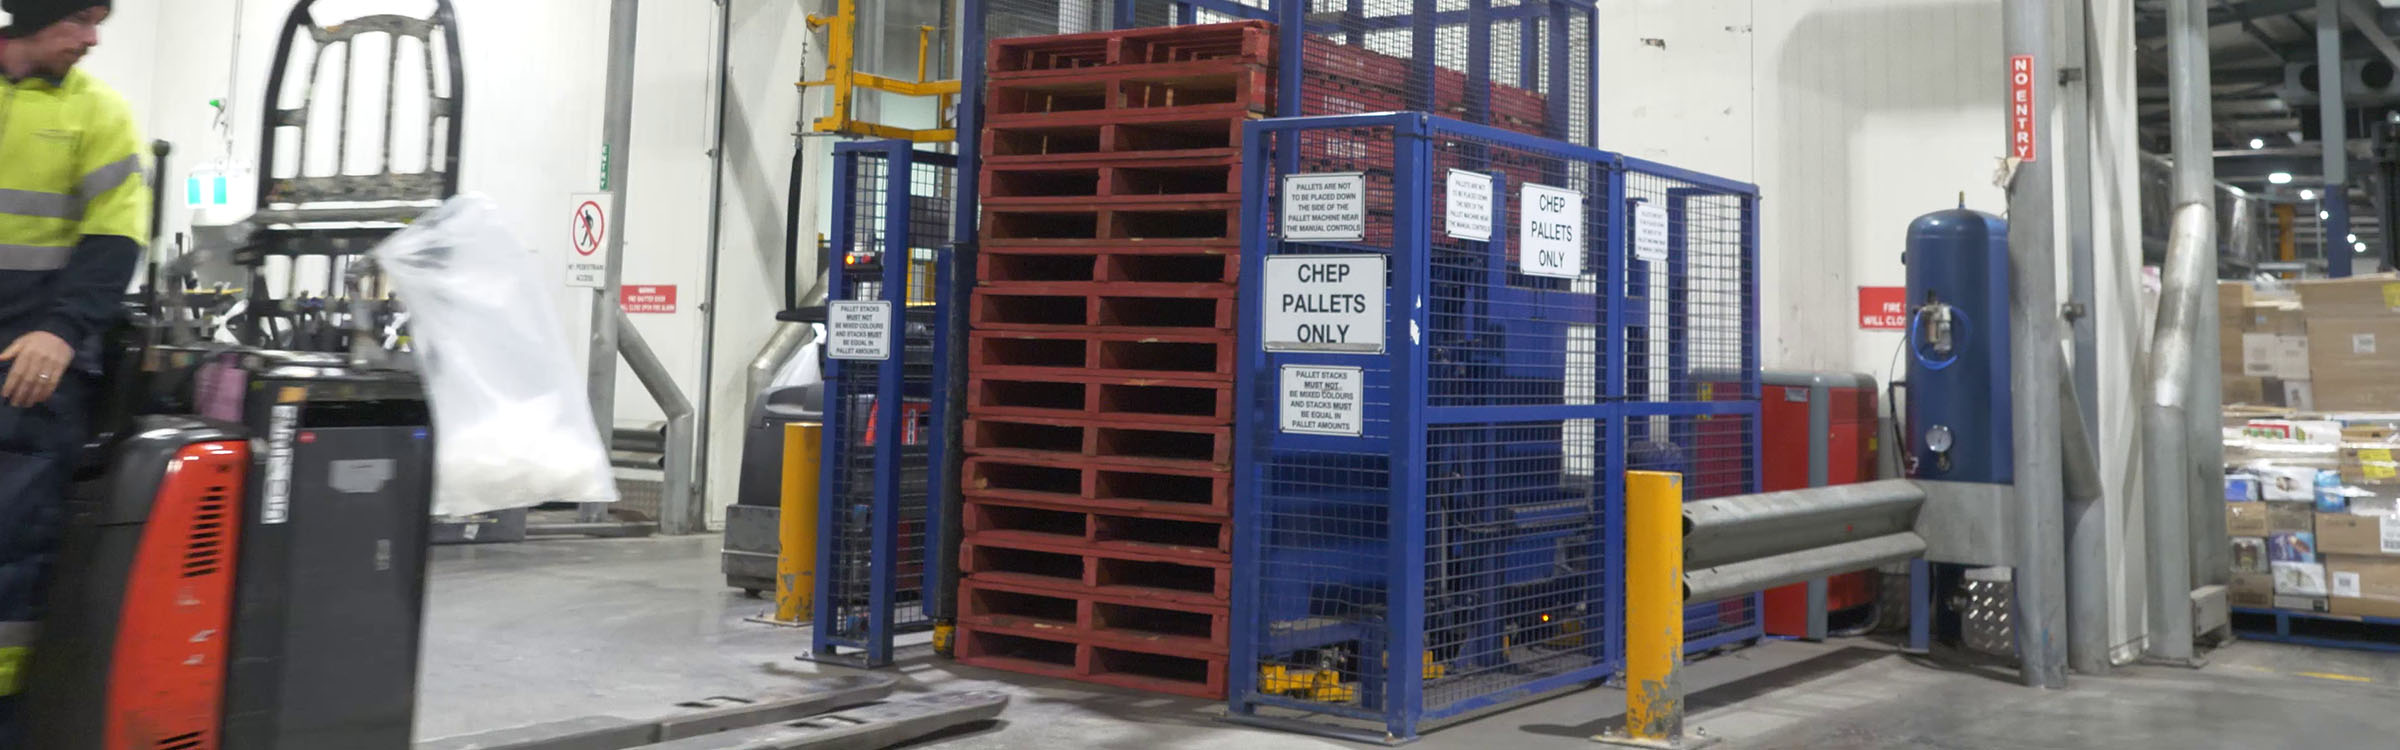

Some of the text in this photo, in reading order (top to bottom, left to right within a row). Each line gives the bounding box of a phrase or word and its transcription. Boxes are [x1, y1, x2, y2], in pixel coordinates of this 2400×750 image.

[2015, 59, 2029, 157] NO ENTRY
[1539, 194, 1565, 213] CHEP
[1531, 220, 1573, 242] PALLETS
[1539, 249, 1564, 268] ONLY
[1298, 264, 1350, 283] CHEP
[1282, 294, 1366, 313] PALLETS
[1883, 302, 1900, 313] FIRE
[1863, 315, 1883, 326] WILL
[1297, 324, 1350, 343] ONLY
[1304, 381, 1339, 390] MUST NOT
[1322, 392, 1354, 400] COLOURS
[1306, 401, 1332, 409] STACKS
[1333, 402, 1352, 410] MUST
[1311, 411, 1332, 419] EQUAL
[1292, 420, 1350, 430] PALLET AMOUNTS
